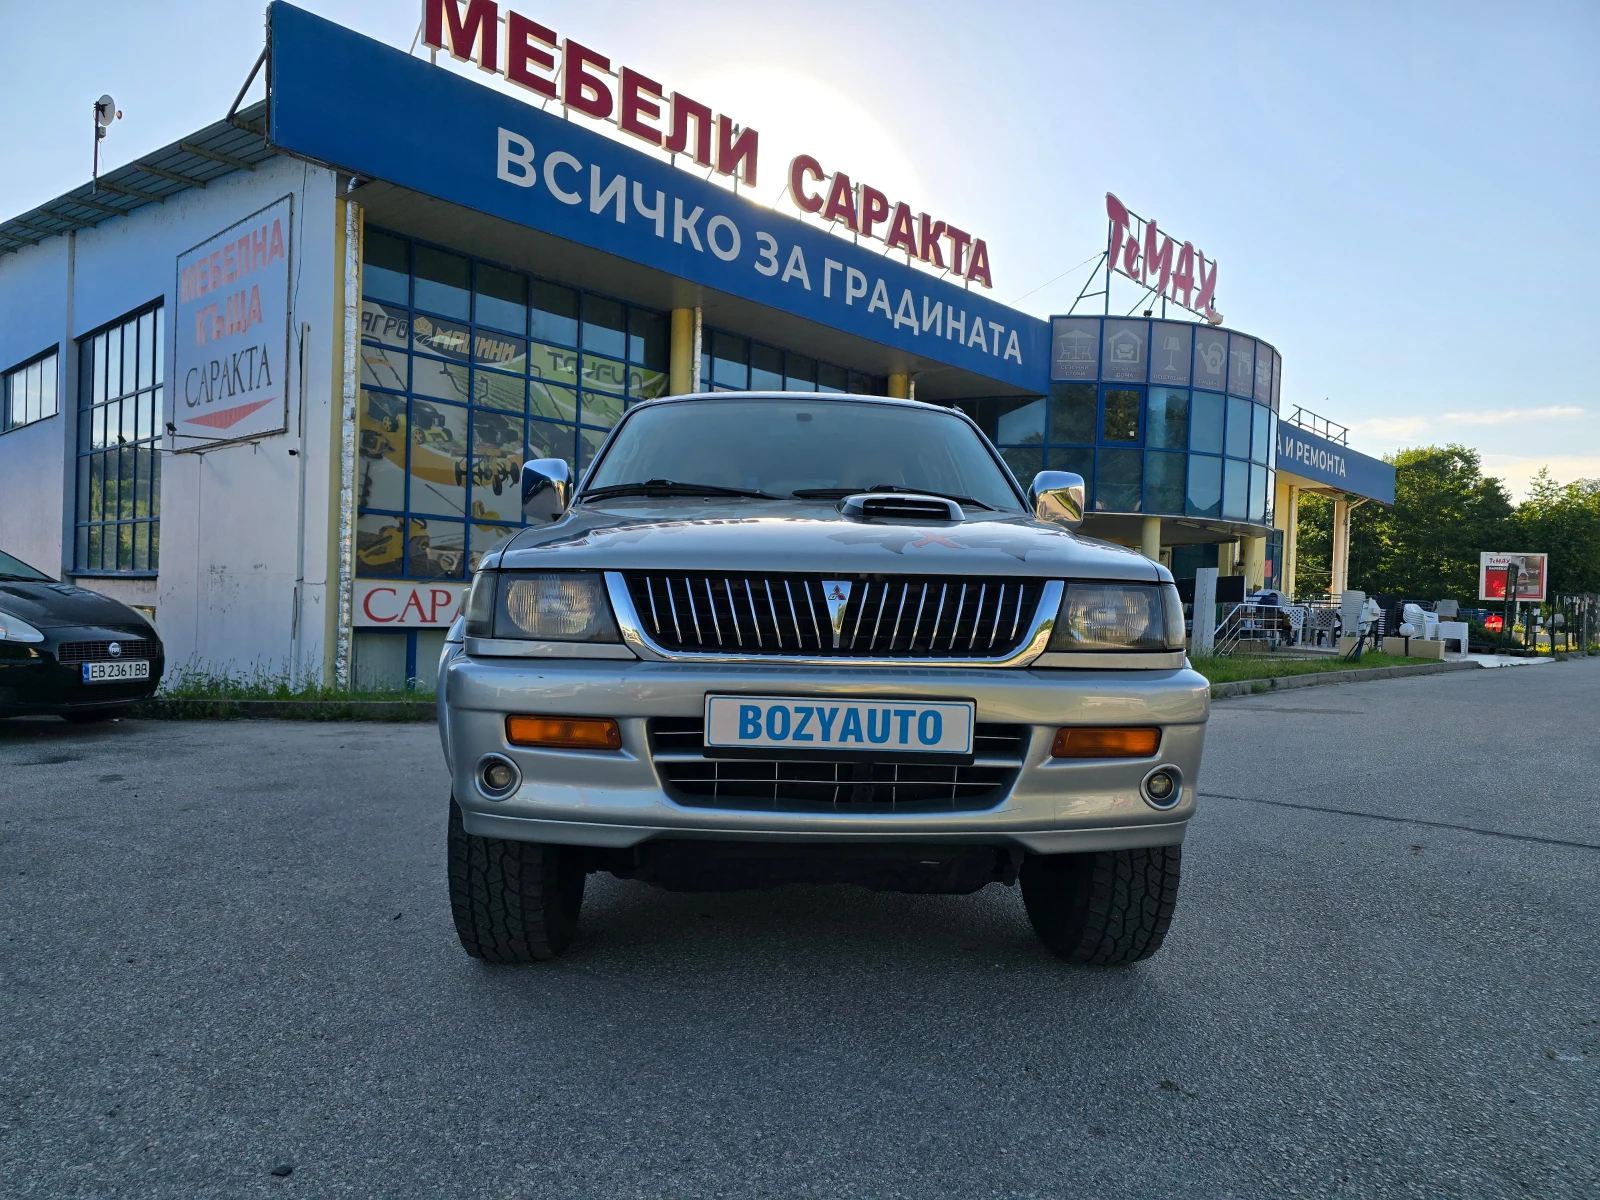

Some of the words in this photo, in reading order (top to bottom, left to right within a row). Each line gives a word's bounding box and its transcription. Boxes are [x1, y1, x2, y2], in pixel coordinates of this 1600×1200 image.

[421, 0, 759, 188] МЕБЕЛИ
[788, 154, 993, 289] САРАКТА
[180, 218, 285, 305] МЕБЕЛНА
[496, 126, 742, 262] ВСИЧКО
[754, 231, 811, 291] ЗА
[823, 257, 1023, 365] ГРАДИНАТА
[195, 284, 263, 347] КЪЩА
[184, 342, 272, 408] САРАКТА
[1285, 436, 1294, 459] И
[1296, 441, 1347, 478] РЕМОНТА
[363, 587, 460, 623] САР
[91, 664, 105, 678] EB
[108, 664, 133, 678] 2361
[135, 663, 148, 676] BB
[738, 704, 943, 746] BOZYAUTO
